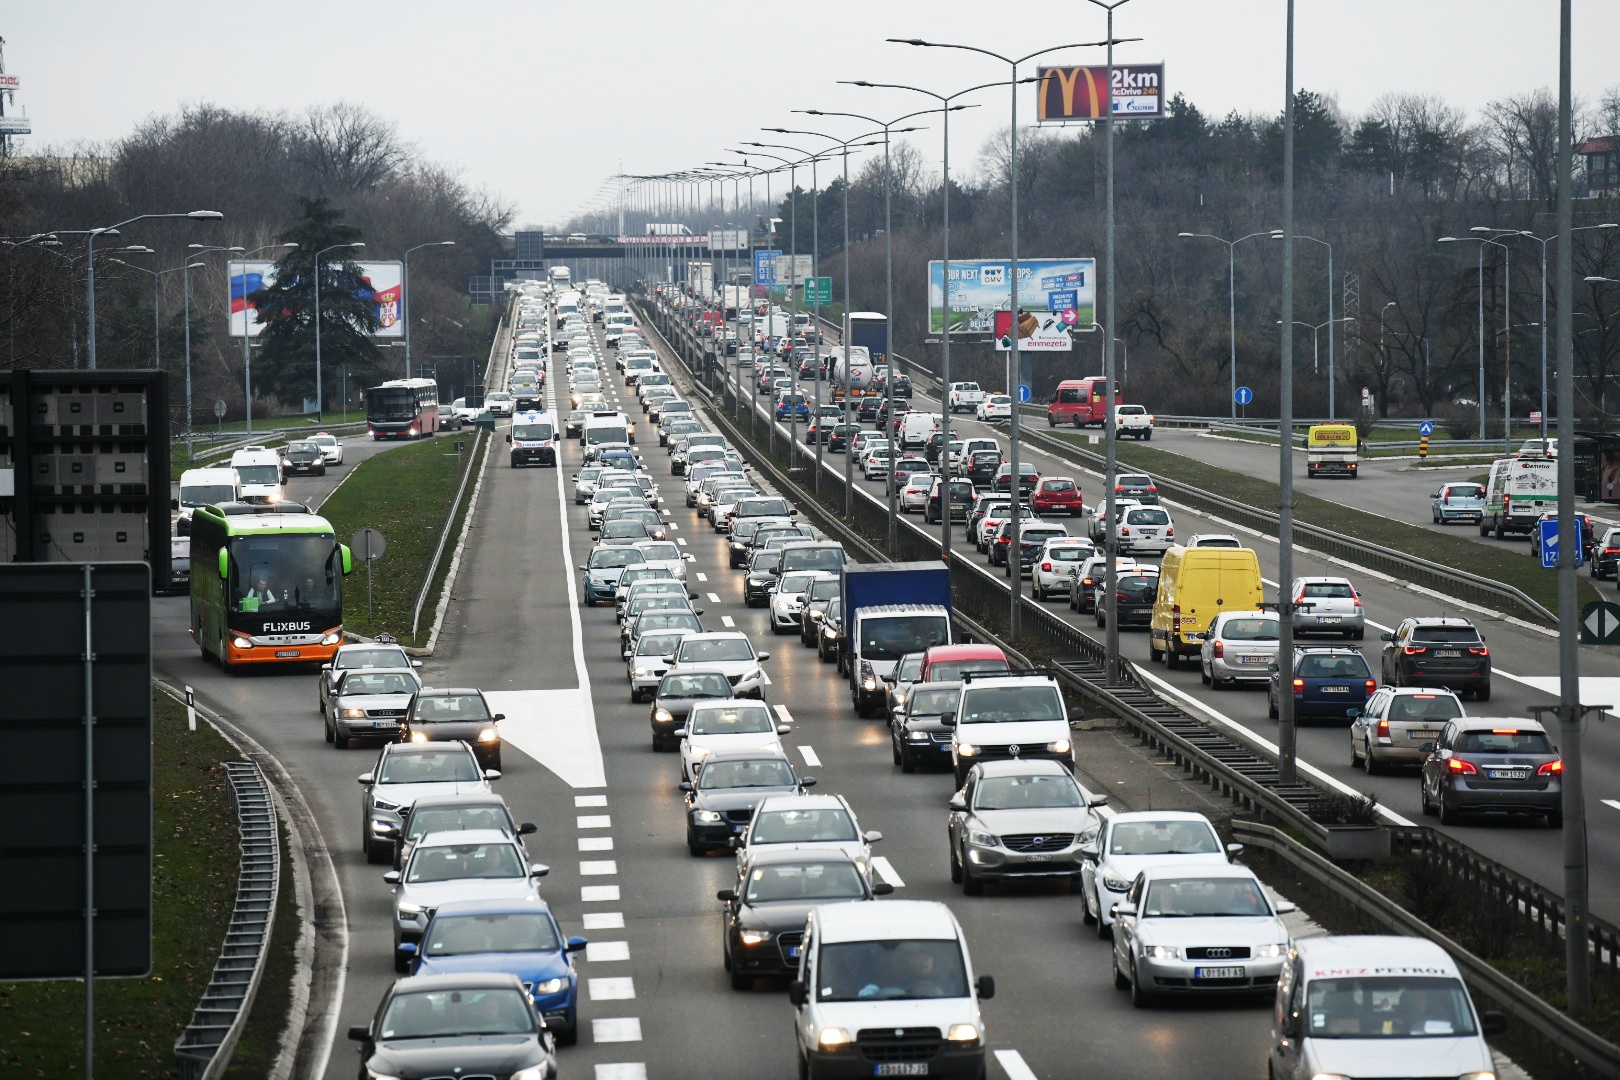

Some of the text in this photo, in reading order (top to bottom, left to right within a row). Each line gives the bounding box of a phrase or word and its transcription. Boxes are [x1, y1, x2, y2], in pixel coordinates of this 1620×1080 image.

[1112, 69, 1158, 87] 2km
[1142, 87, 1158, 95] 24h
[942, 269, 960, 280] OUR
[962, 269, 979, 280] NEXT
[1008, 268, 1033, 279] SOPS:
[970, 320, 994, 328] BELGRA
[1027, 340, 1067, 348] emmezeta
[1374, 967, 1449, 976] PETROL
